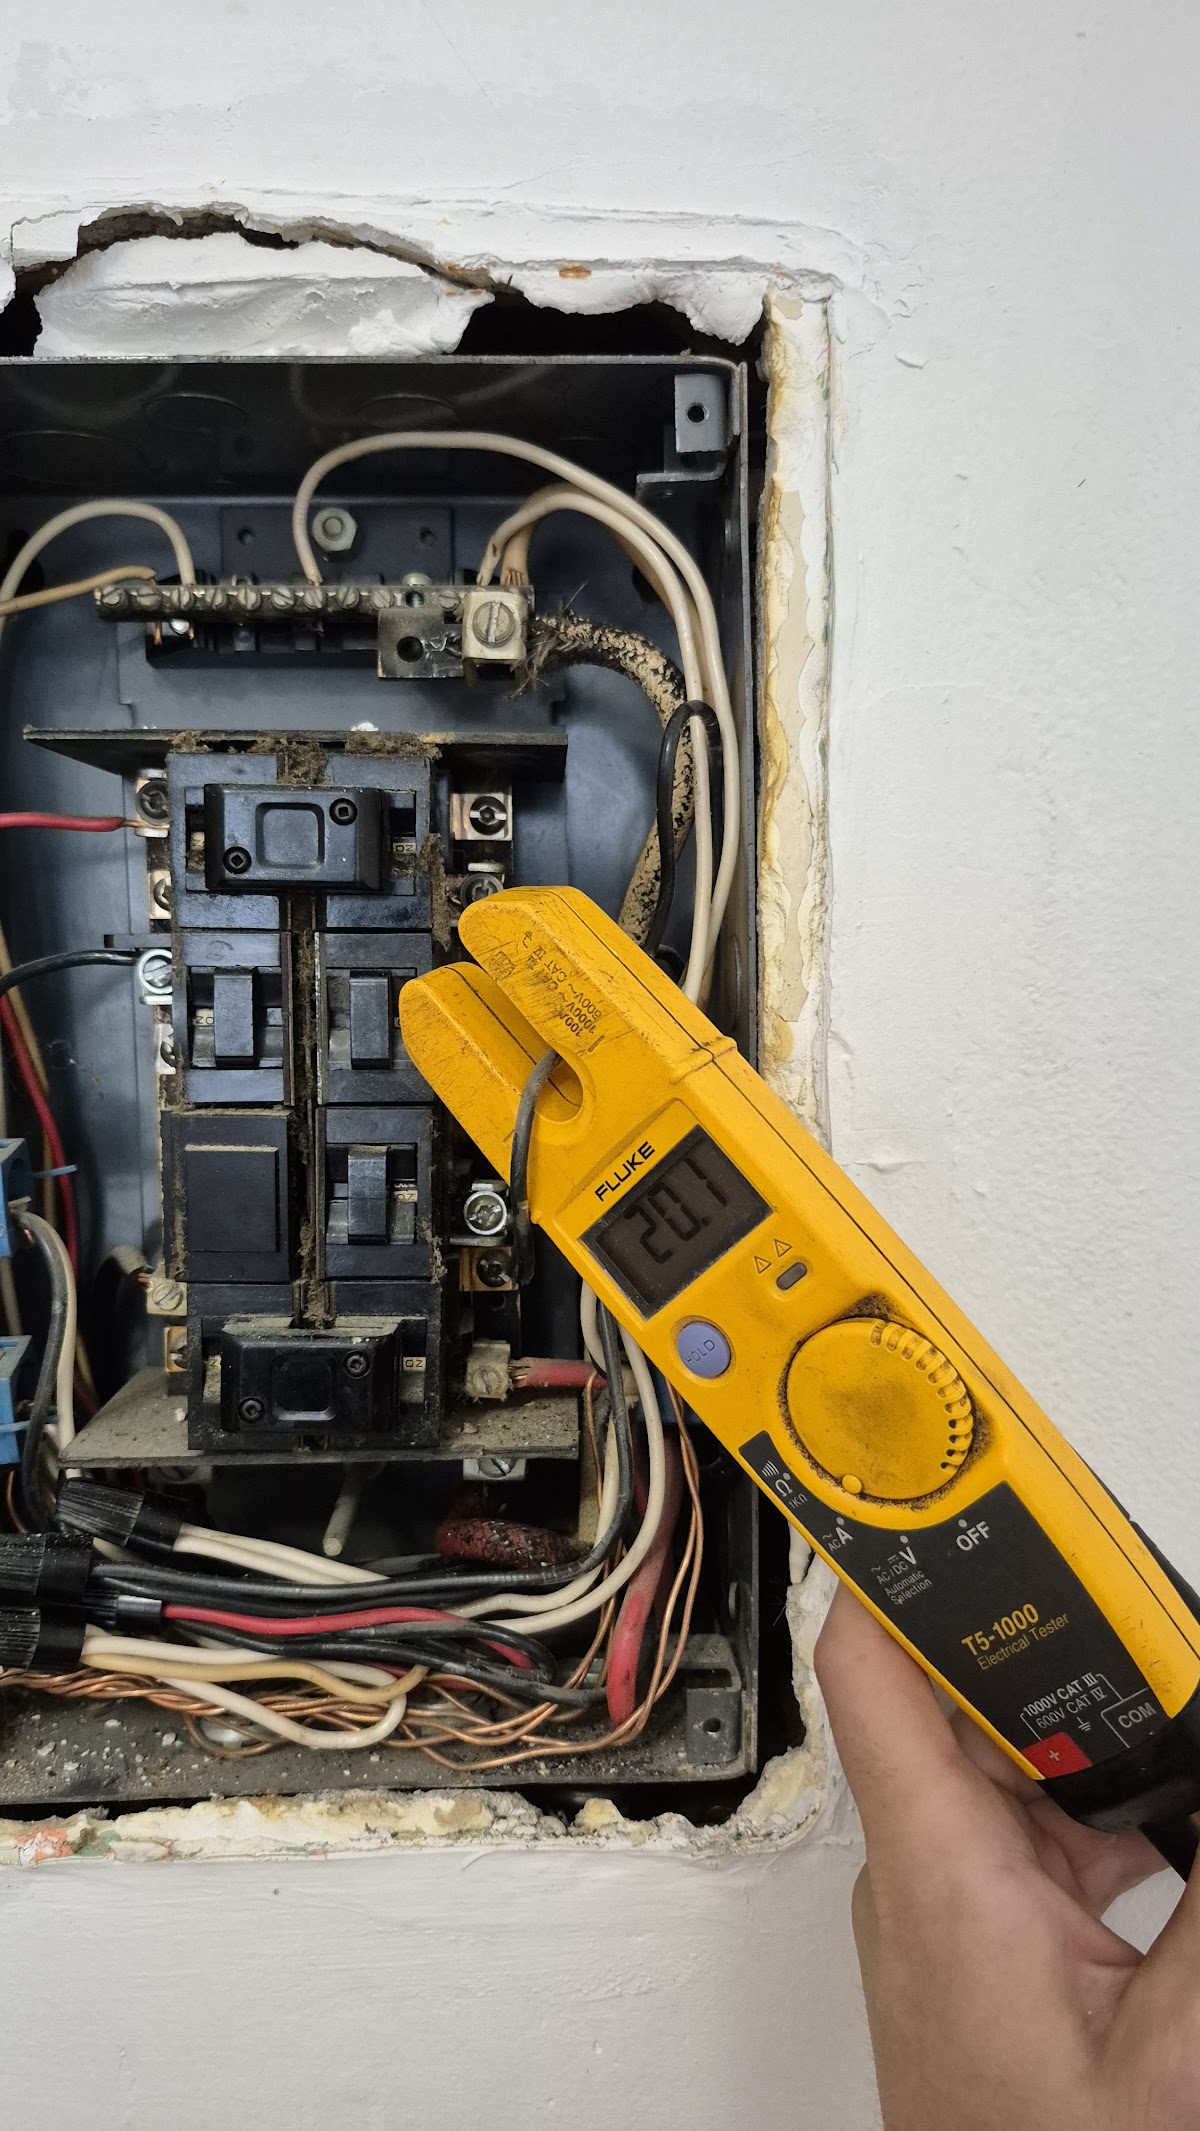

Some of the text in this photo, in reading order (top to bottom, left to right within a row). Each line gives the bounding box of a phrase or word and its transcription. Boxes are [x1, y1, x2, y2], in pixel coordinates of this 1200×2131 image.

[533, 945, 547, 961] IV
[544, 960, 567, 983] CAT
[594, 1141, 656, 1202] FLUKE
[622, 1157, 728, 1265] 20.1
[685, 1339, 715, 1367] HOLD
[956, 1520, 990, 1551] OFF
[898, 1546, 917, 1565] V
[884, 1570, 925, 1597] Automatic
[890, 1578, 933, 1605] Selection
[961, 1603, 1039, 1656] T5-1000
[976, 1612, 1070, 1670] Electrical Tester
[1023, 1672, 1099, 1717] 1000V CAT III
[1035, 1686, 1107, 1729] 600V CAT IV
[1118, 1702, 1157, 1728] COM
